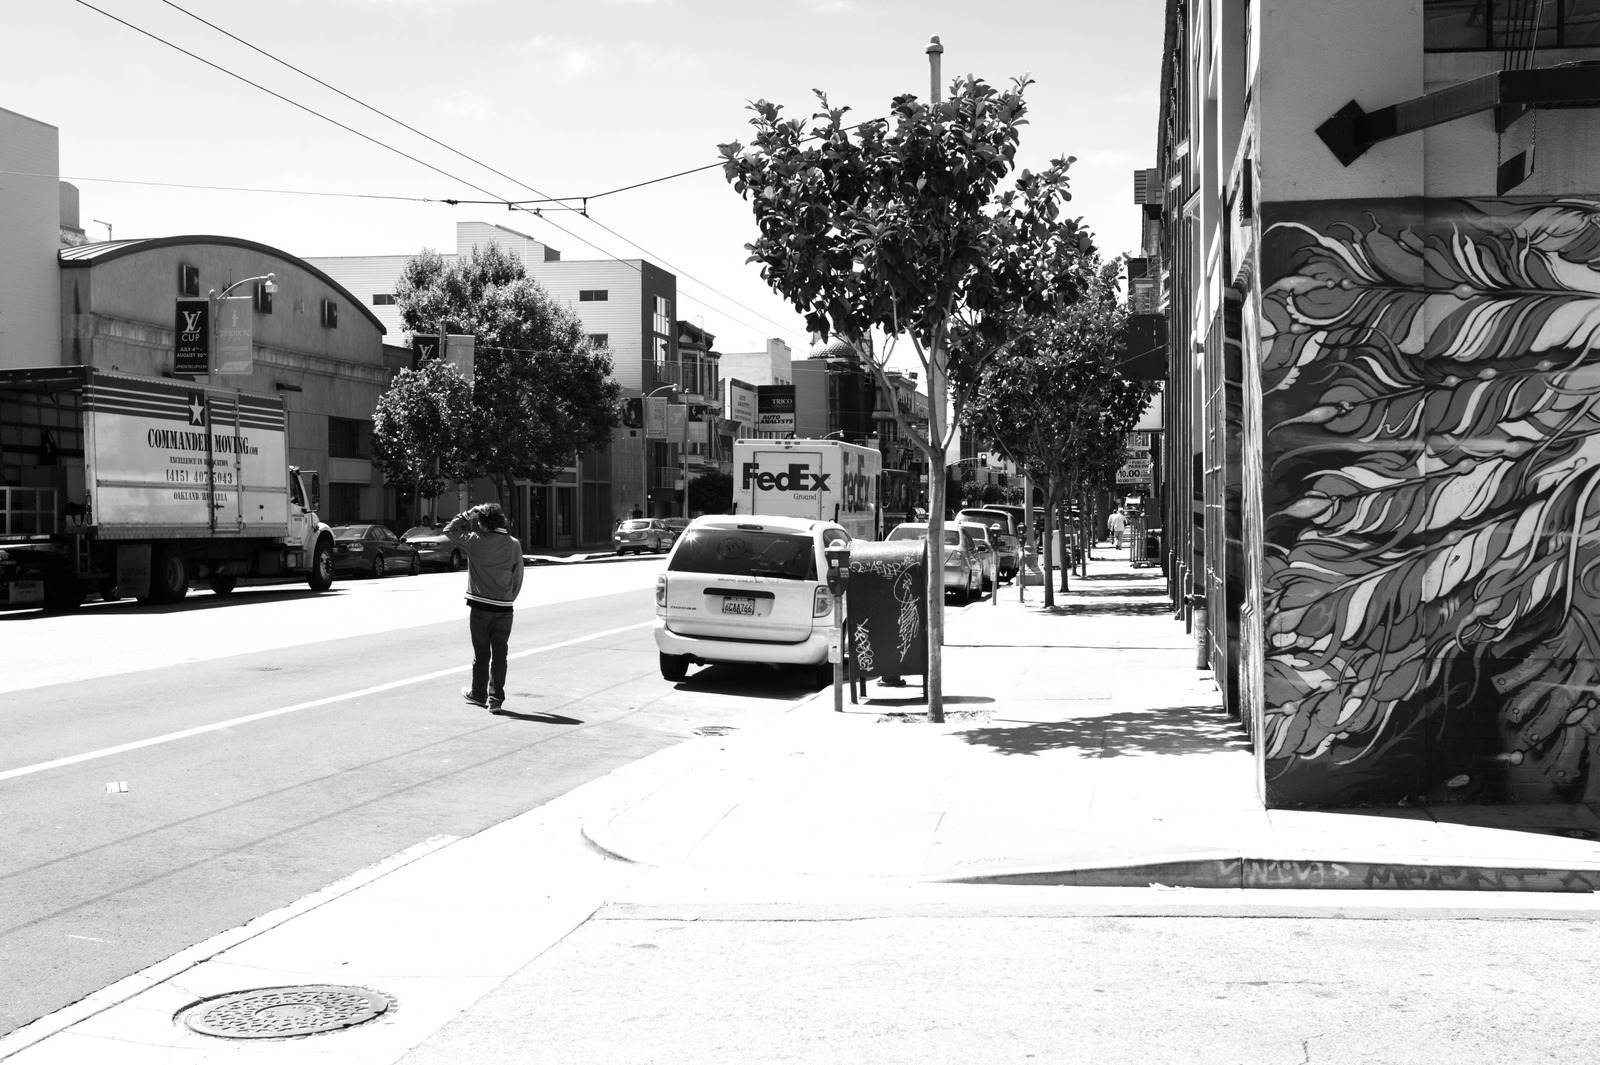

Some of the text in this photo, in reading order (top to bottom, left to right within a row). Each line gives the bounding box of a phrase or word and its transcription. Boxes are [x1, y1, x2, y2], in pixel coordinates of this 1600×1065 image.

[182, 334, 200, 342] CUP
[147, 428, 211, 453] COMMANDER
[169, 456, 229, 467] EXCELLENCE IN RCATION
[166, 468, 189, 482] (415)
[742, 462, 832, 492] FedEx
[214, 493, 228, 502] AREA
[793, 492, 817, 501] Ground
[724, 602, 753, 613] 6CAA766
